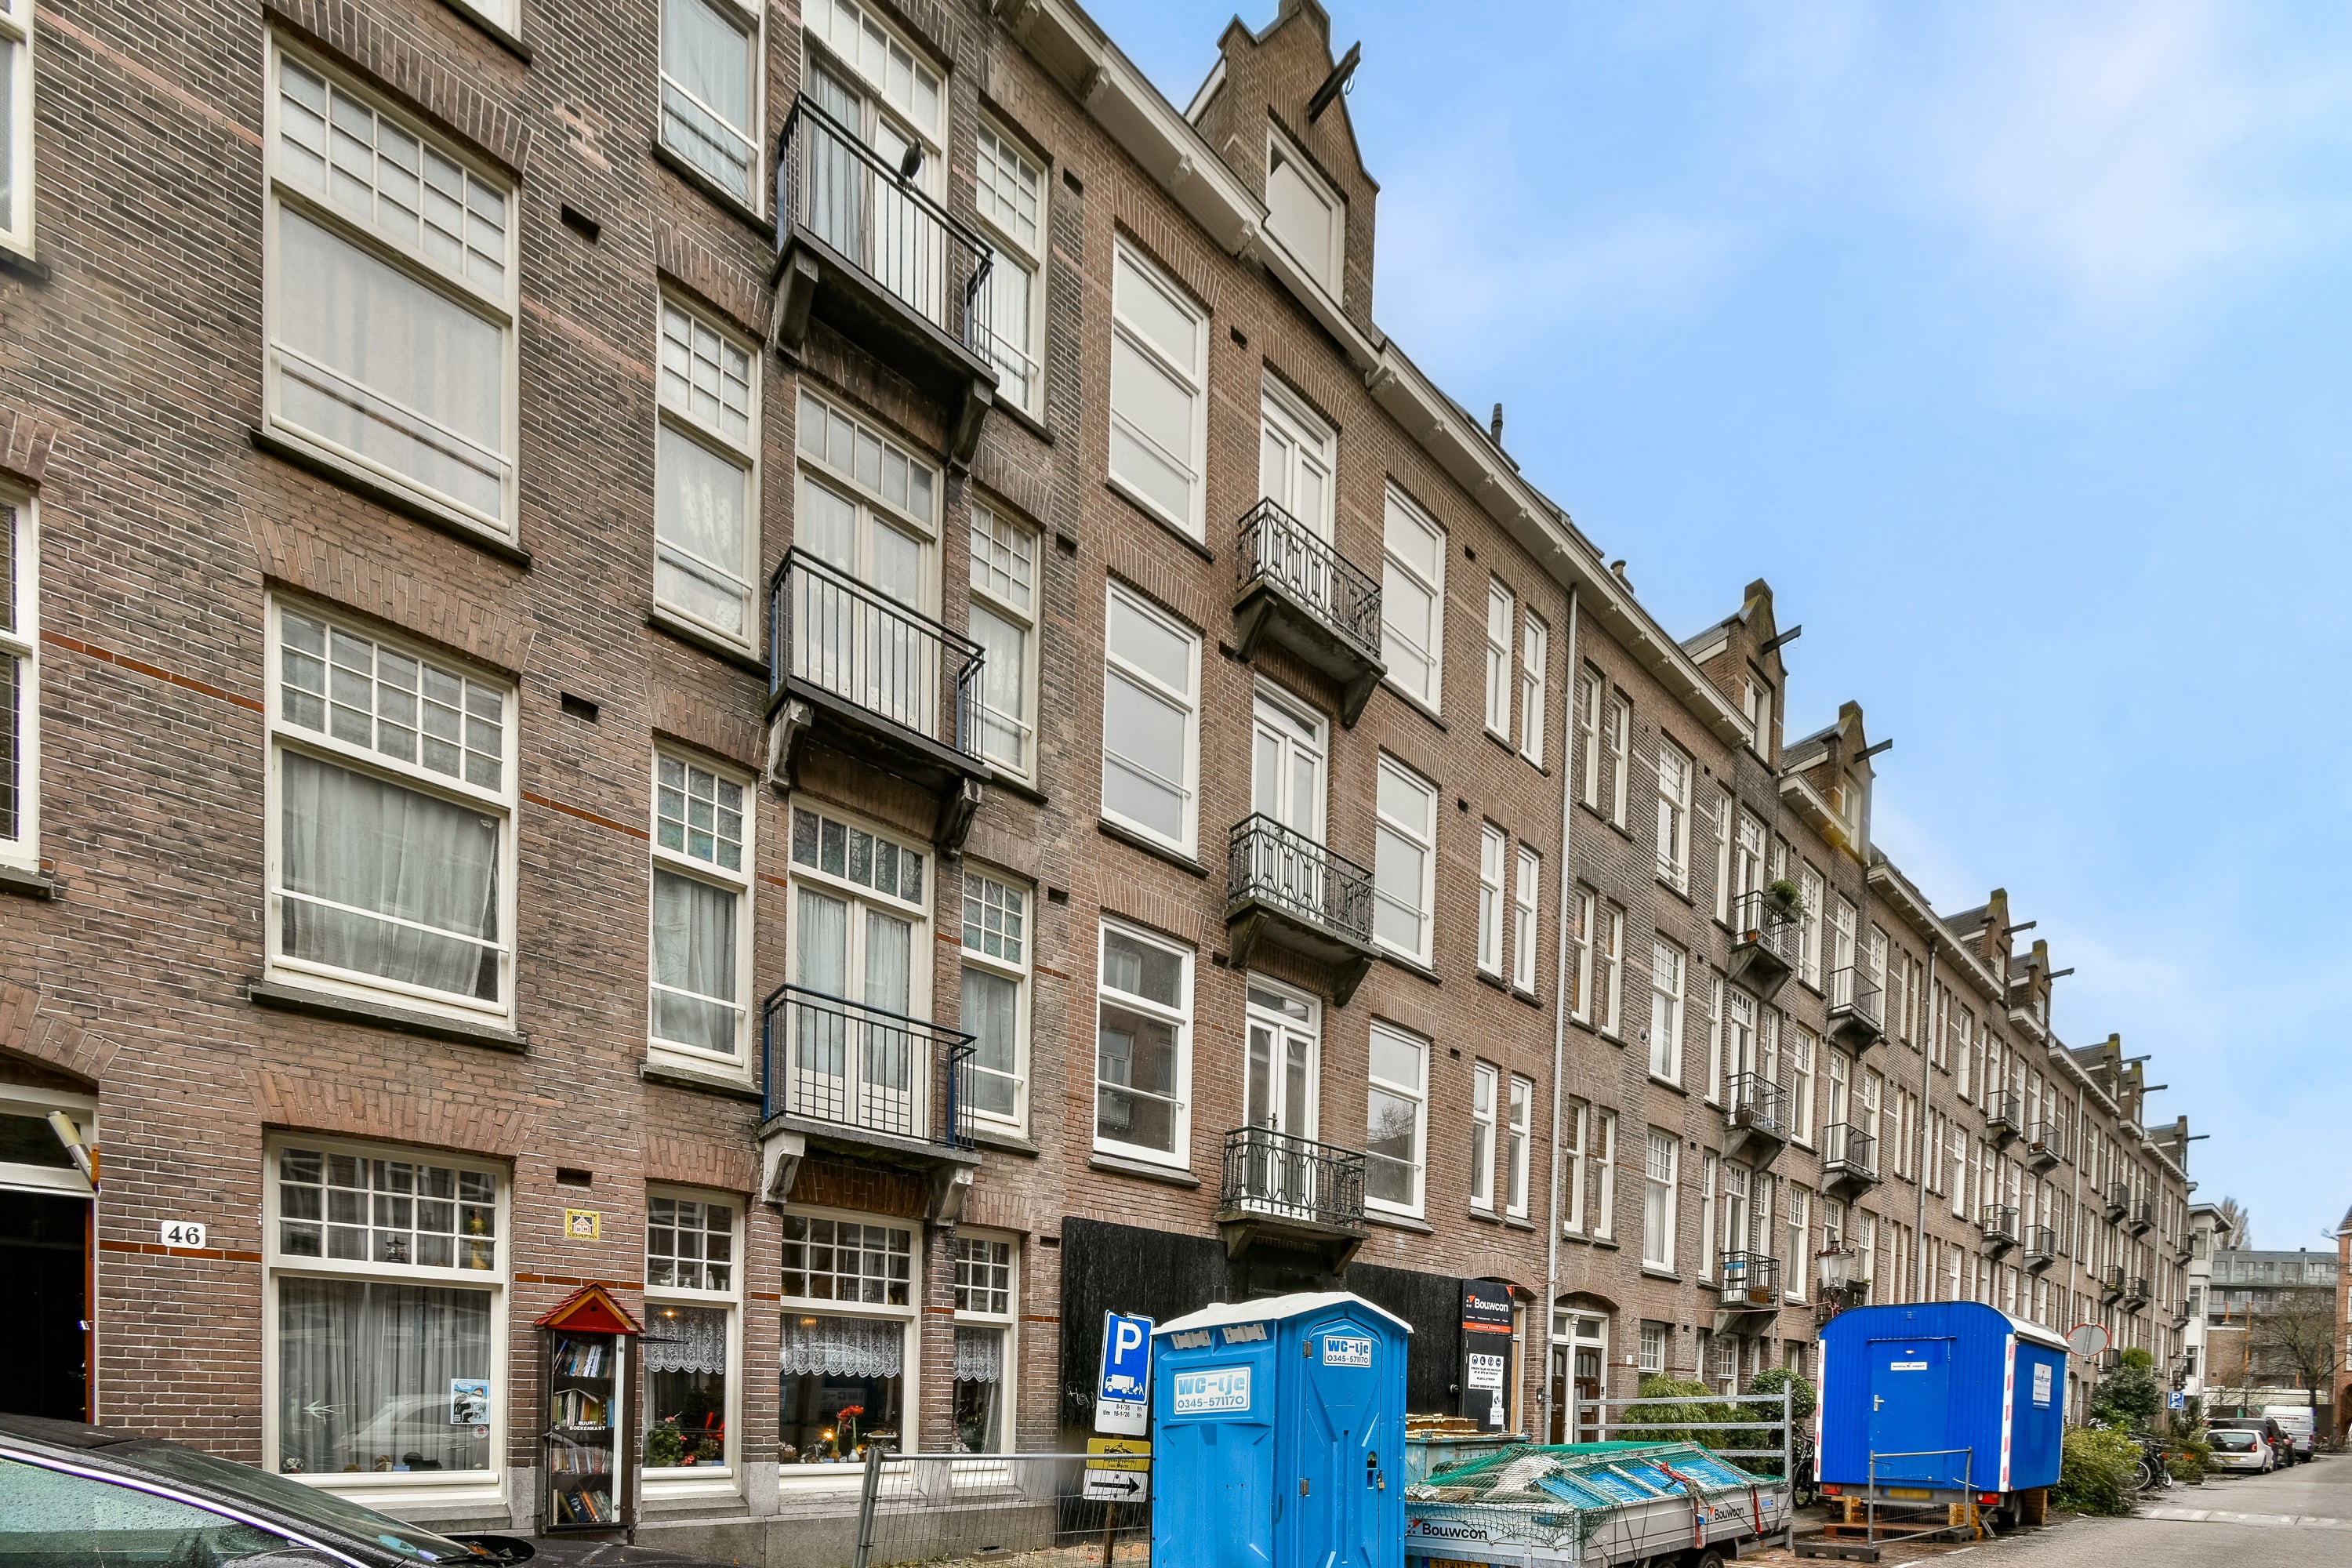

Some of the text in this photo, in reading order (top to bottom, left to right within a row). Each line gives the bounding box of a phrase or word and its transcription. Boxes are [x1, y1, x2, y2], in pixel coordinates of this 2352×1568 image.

[168, 1225, 200, 1245] 46
[1474, 1298, 1508, 1312] Bouwcon
[1114, 1321, 1142, 1365] P
[1327, 1355, 1369, 1363] 0345-571170
[1178, 1396, 1244, 1409] 0345-571170
[2172, 1392, 2180, 1402] P
[1715, 1506, 1744, 1520] Bouwcon
[1422, 1523, 1487, 1540] Bouwcon
